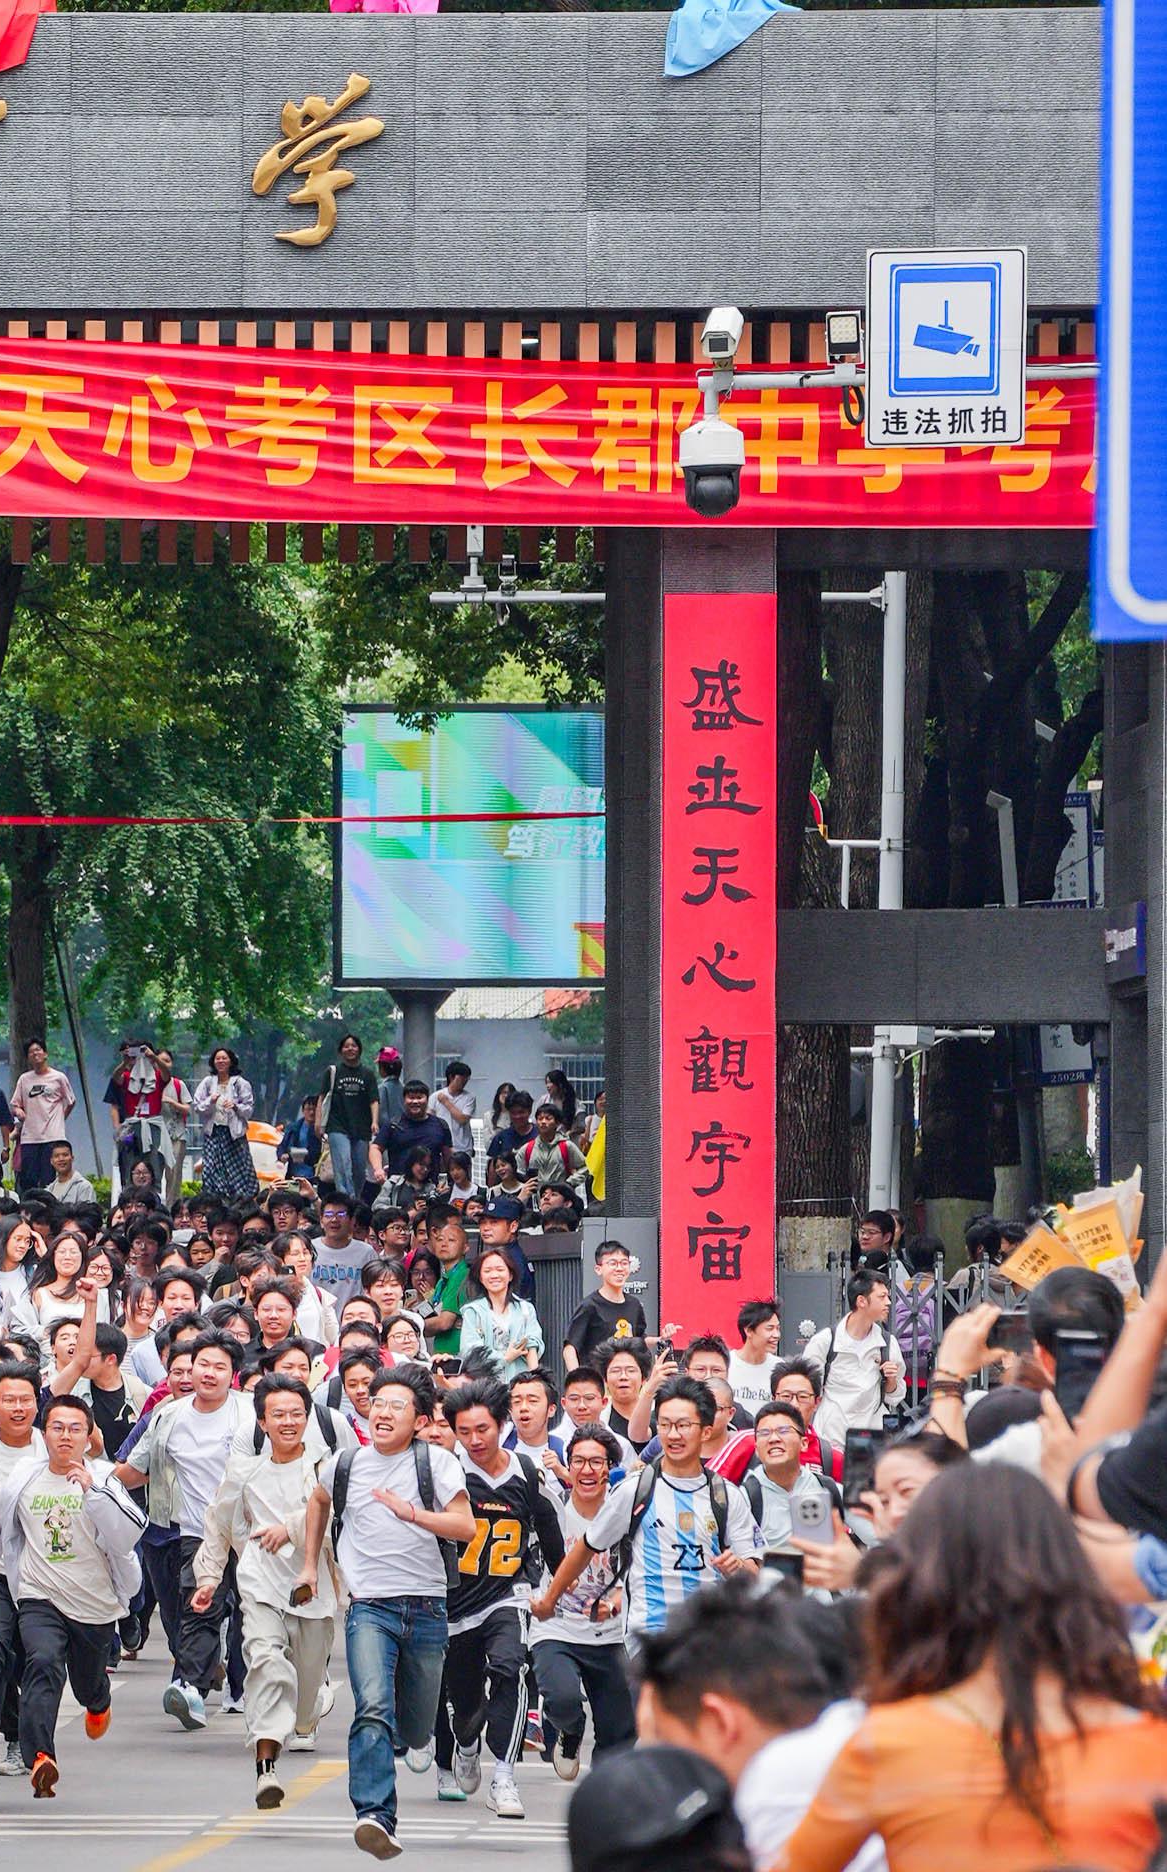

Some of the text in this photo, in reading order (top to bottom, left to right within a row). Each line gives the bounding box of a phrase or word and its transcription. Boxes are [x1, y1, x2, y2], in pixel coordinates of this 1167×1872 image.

[881, 404, 1009, 436] 违法抓拍
[458, 1517, 523, 1577] 72
